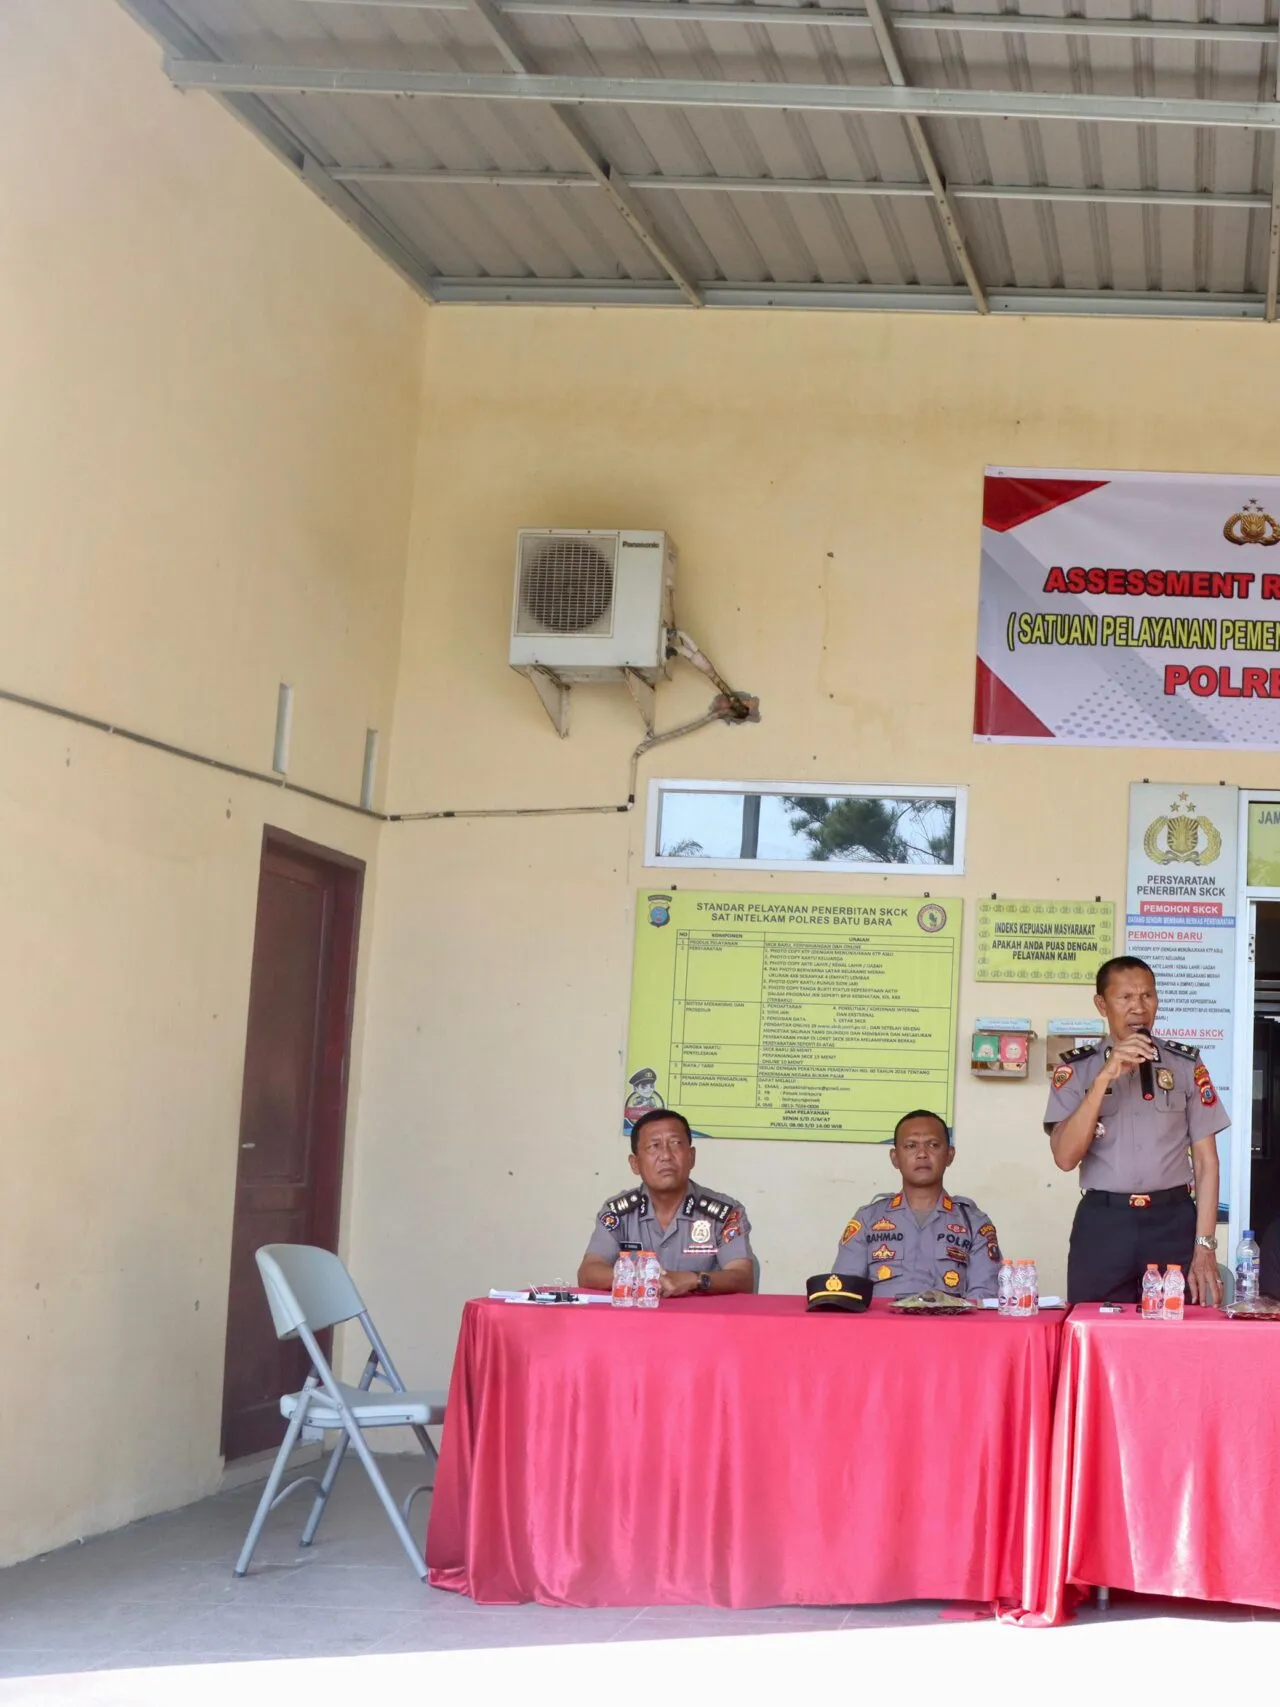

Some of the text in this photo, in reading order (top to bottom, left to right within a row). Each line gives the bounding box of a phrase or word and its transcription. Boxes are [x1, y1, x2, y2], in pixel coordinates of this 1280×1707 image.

[622, 541, 660, 549] Panasonic
[1043, 566, 1255, 599] ASSESSMENT
[1018, 612, 1098, 646] SATUAN
[1101, 616, 1216, 650] PELAYANAN
[1147, 875, 1216, 886] PERSYARATAN
[1136, 885, 1226, 897] PENERBITAN SKCK
[696, 902, 908, 917] STANDAR PELAYANAN PENERBITAN SKCK
[1143, 904, 1219, 914] PEMOHON SKCK
[711, 912, 893, 926] SAT INTELKAM POLRES BATU BARA
[994, 922, 1096, 936] INDEKS KEPUASAN MASYARAKAT
[1127, 931, 1203, 940] PEMOHON BARU
[992, 940, 1098, 952] APAKAH ANDA PUAS DENGAN
[1012, 950, 1077, 961] PELAYANAN KAMI
[1199, 1029, 1224, 1037] SKCK
